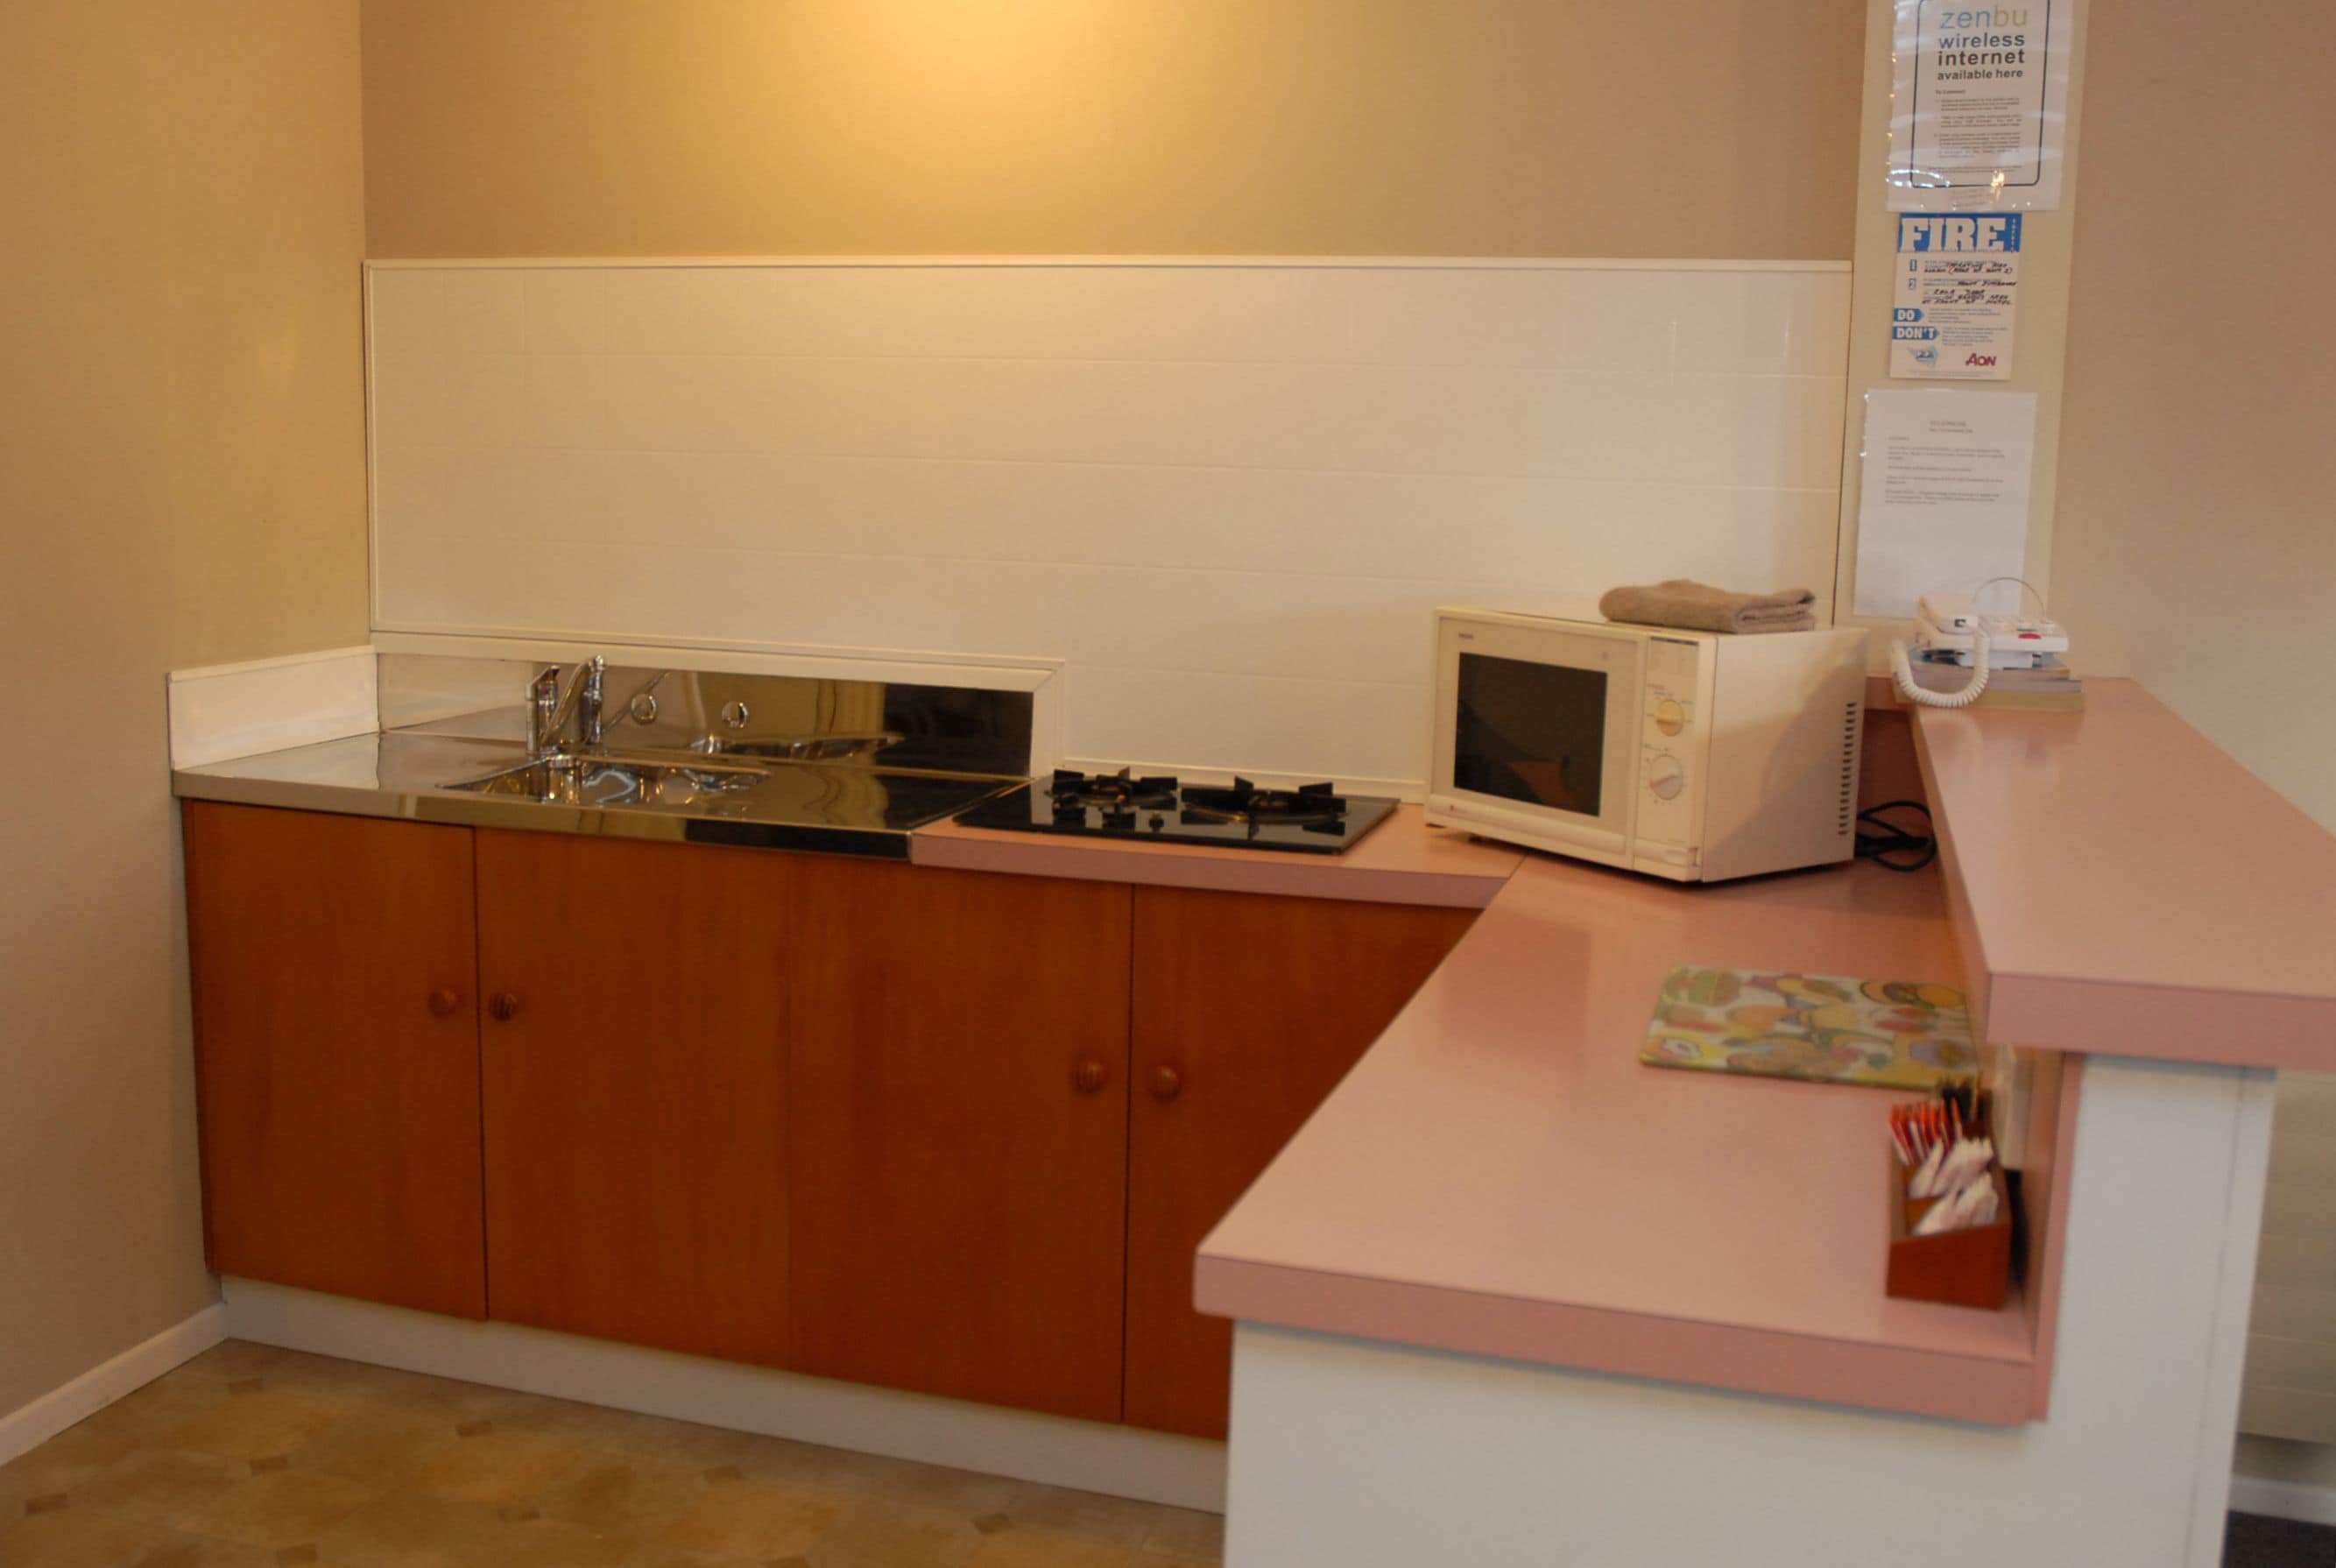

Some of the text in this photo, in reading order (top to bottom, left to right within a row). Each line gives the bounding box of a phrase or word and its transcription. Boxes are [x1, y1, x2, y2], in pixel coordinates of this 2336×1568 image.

[1940, 5, 2028, 29] zenbu
[1938, 32, 2025, 48] wireless
[1937, 49, 2025, 66] internet
[1937, 69, 2023, 81] available here
[1900, 217, 2007, 252] FIRE
[1897, 310, 1915, 321] DO
[1896, 327, 1935, 339] DON'T
